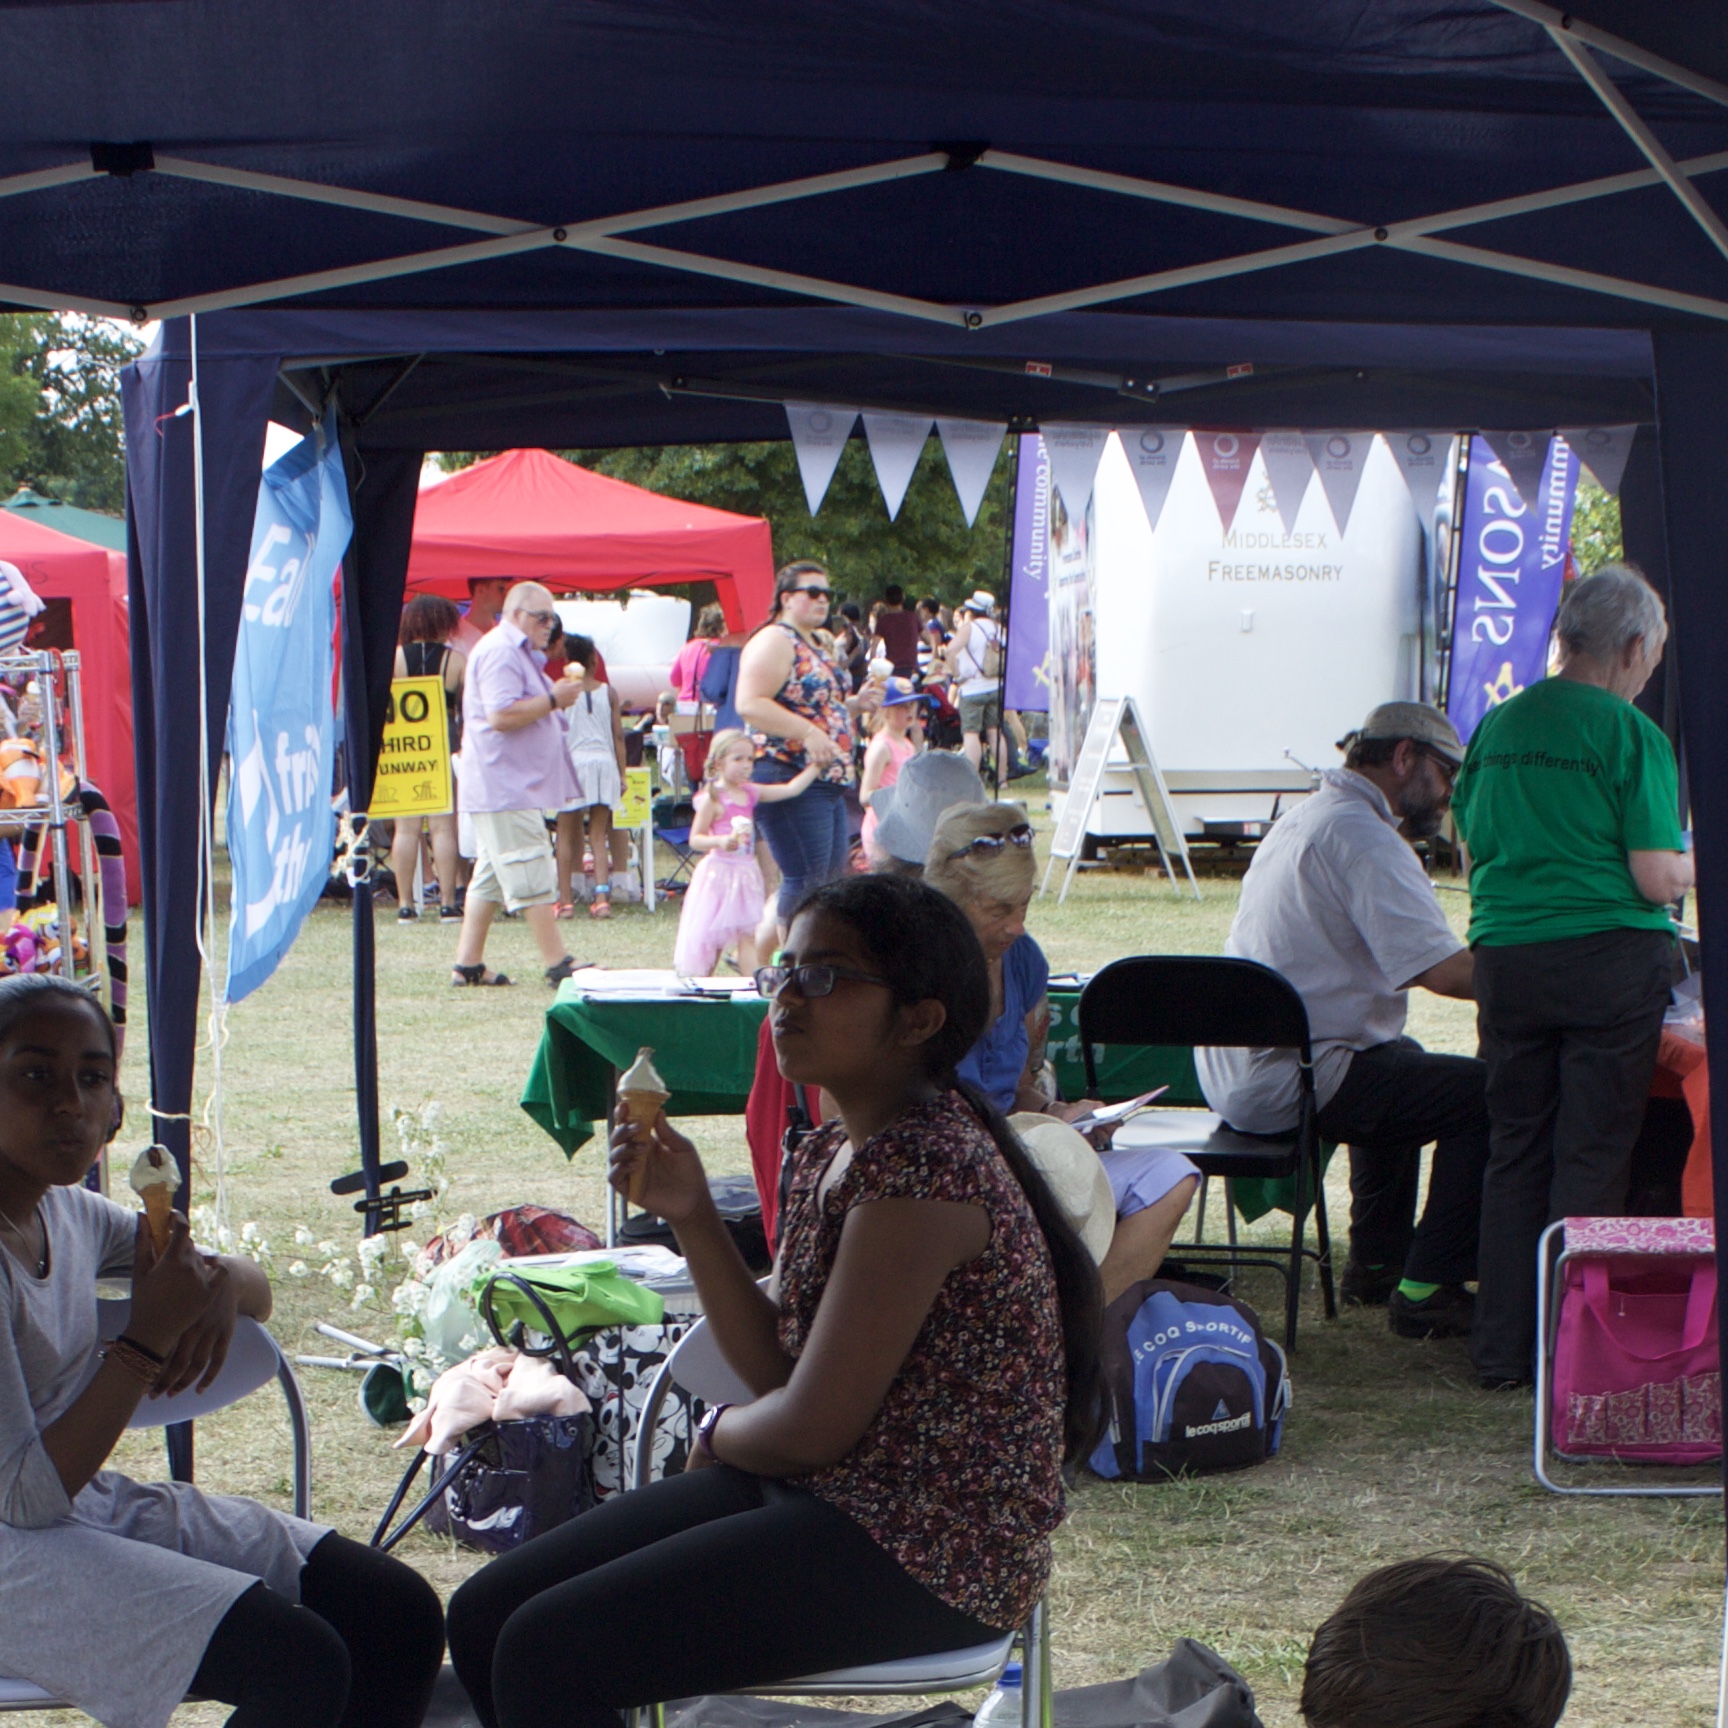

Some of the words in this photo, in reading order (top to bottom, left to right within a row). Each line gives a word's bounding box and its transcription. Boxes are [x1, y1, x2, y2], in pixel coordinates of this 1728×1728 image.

[1023, 463, 1050, 581] community
[1221, 528, 1328, 550] MIDDLESEX
[1207, 560, 1344, 582] FREEMASONRY
[381, 734, 432, 754] HIRD
[377, 760, 438, 776] UNWAY
[1520, 751, 1598, 778] differently
[1142, 1326, 1181, 1352] COQ
